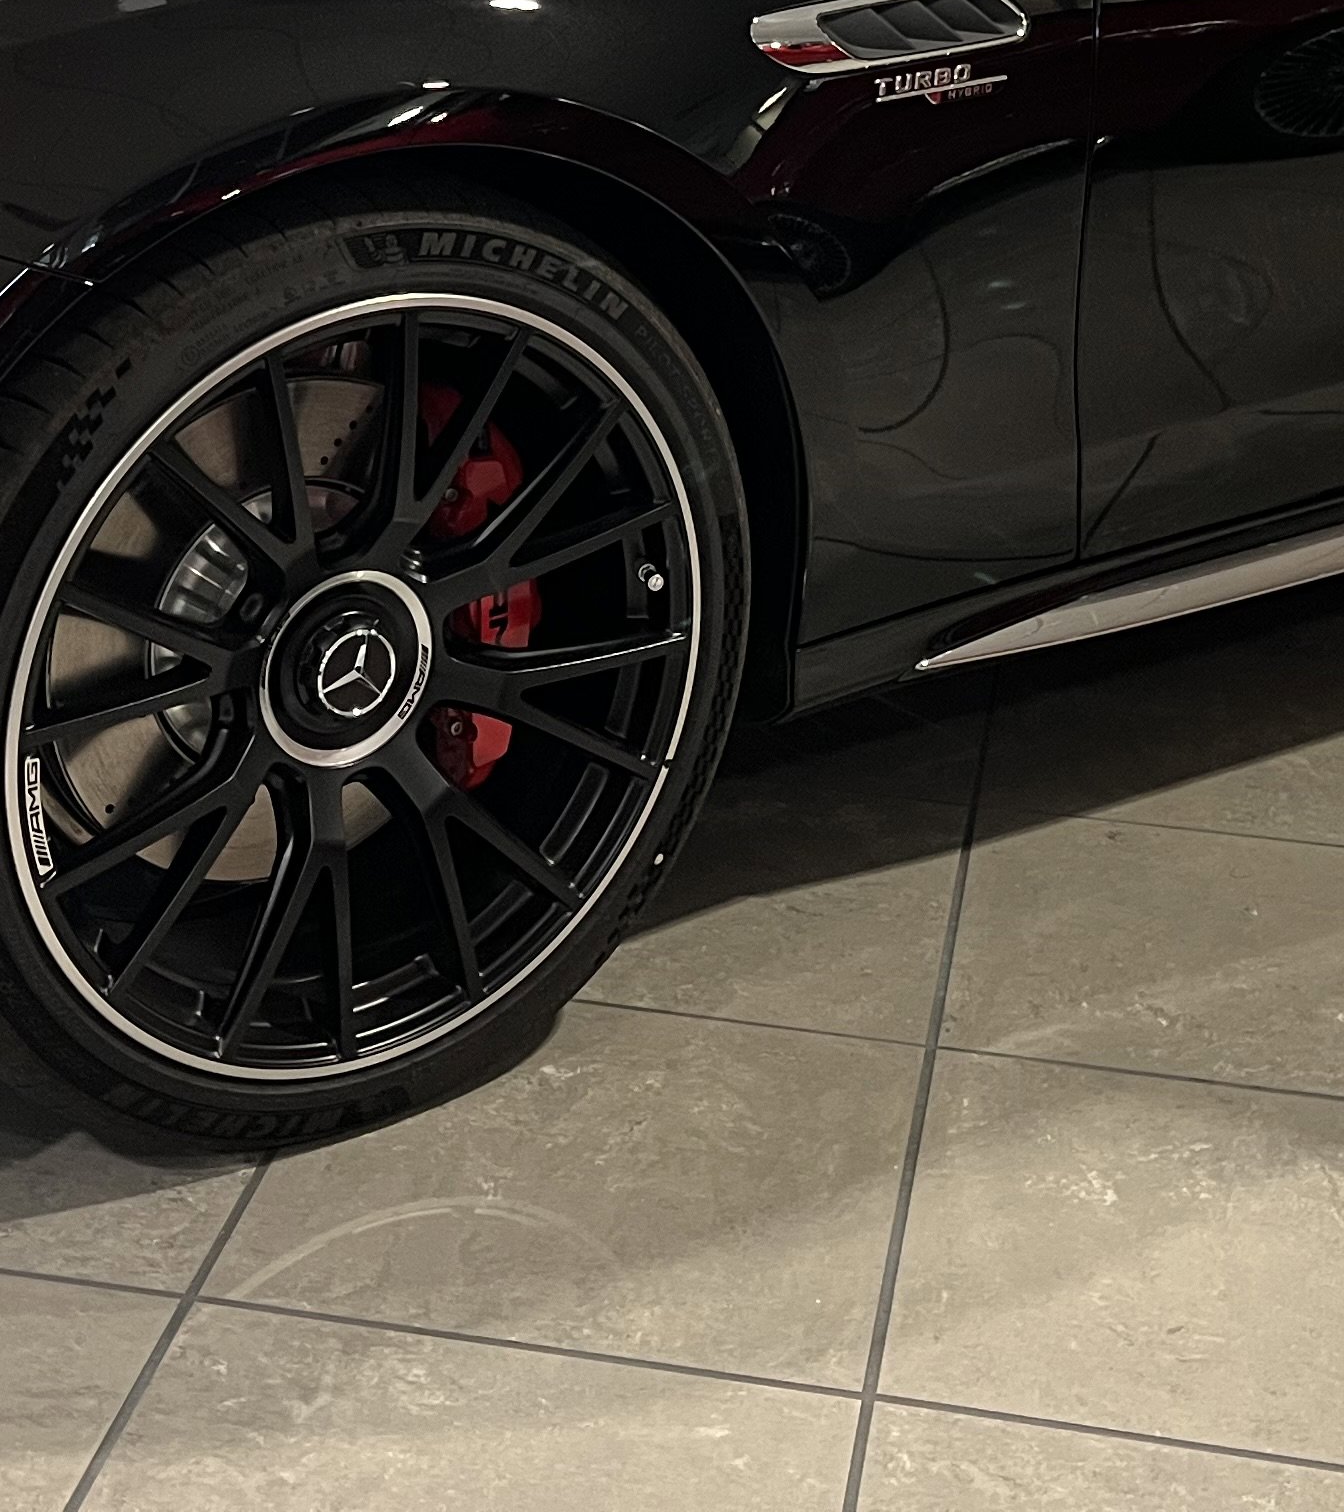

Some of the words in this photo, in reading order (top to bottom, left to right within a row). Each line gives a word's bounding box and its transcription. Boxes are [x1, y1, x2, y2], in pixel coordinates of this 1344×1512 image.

[873, 63, 972, 97] TURBO
[947, 83, 993, 100] HYBRID
[417, 232, 631, 321] MICHELIN
